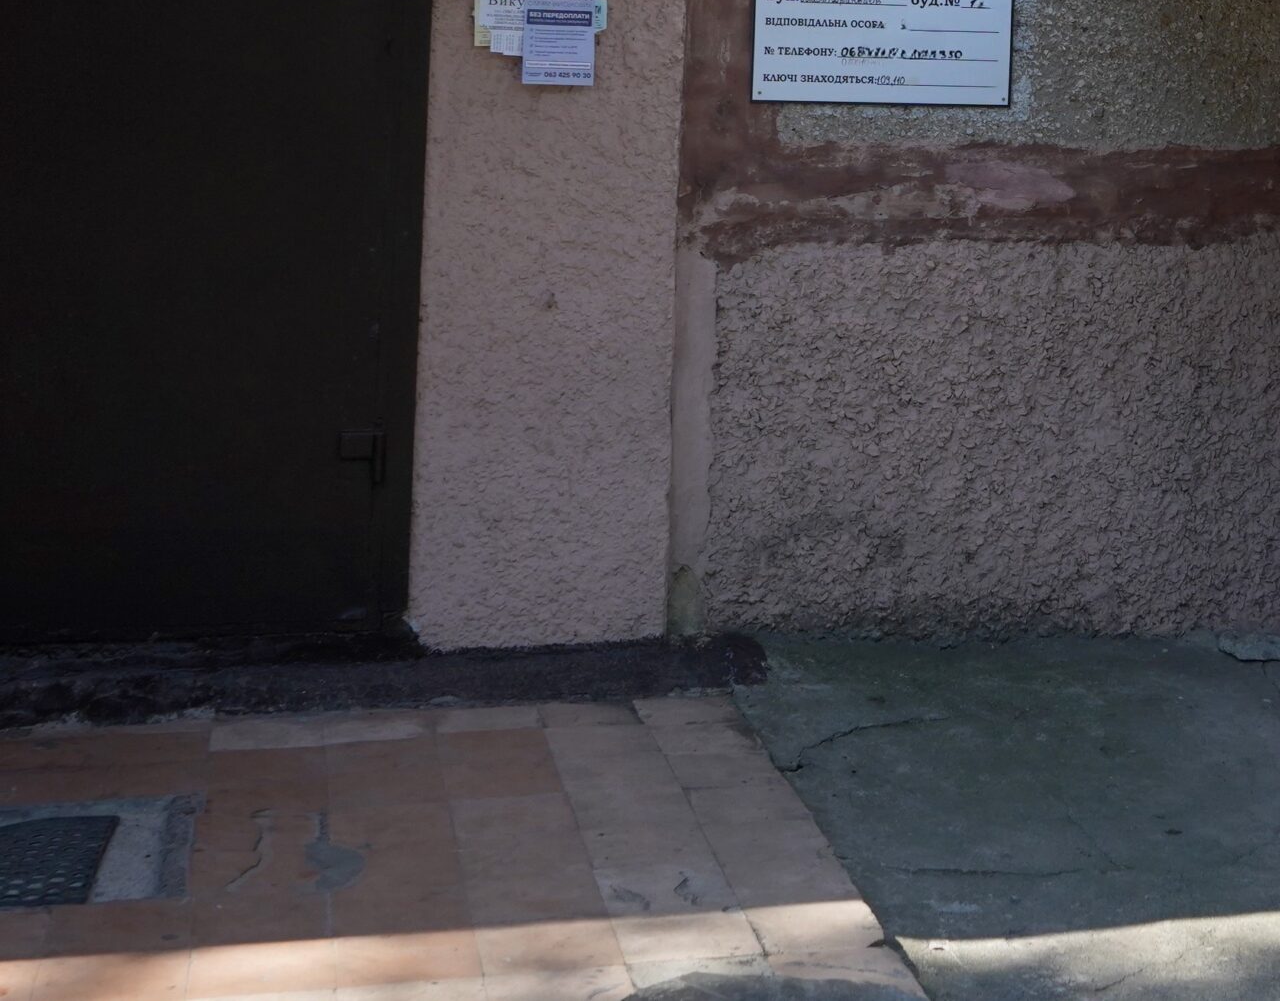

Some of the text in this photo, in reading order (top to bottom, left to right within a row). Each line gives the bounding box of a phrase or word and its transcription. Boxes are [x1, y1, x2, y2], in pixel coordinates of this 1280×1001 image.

[542, 11, 590, 19] ПЕРЕДОПЛАТИ
[765, 17, 848, 28] ВІДПОВІДАЛЬНА
[764, 46, 775, 55] №
[777, 46, 837, 57] ТЕЛЕФОНУ:
[763, 74, 877, 84] КЛЮЧІ ЗНАХОДЯТЬСЯ:
